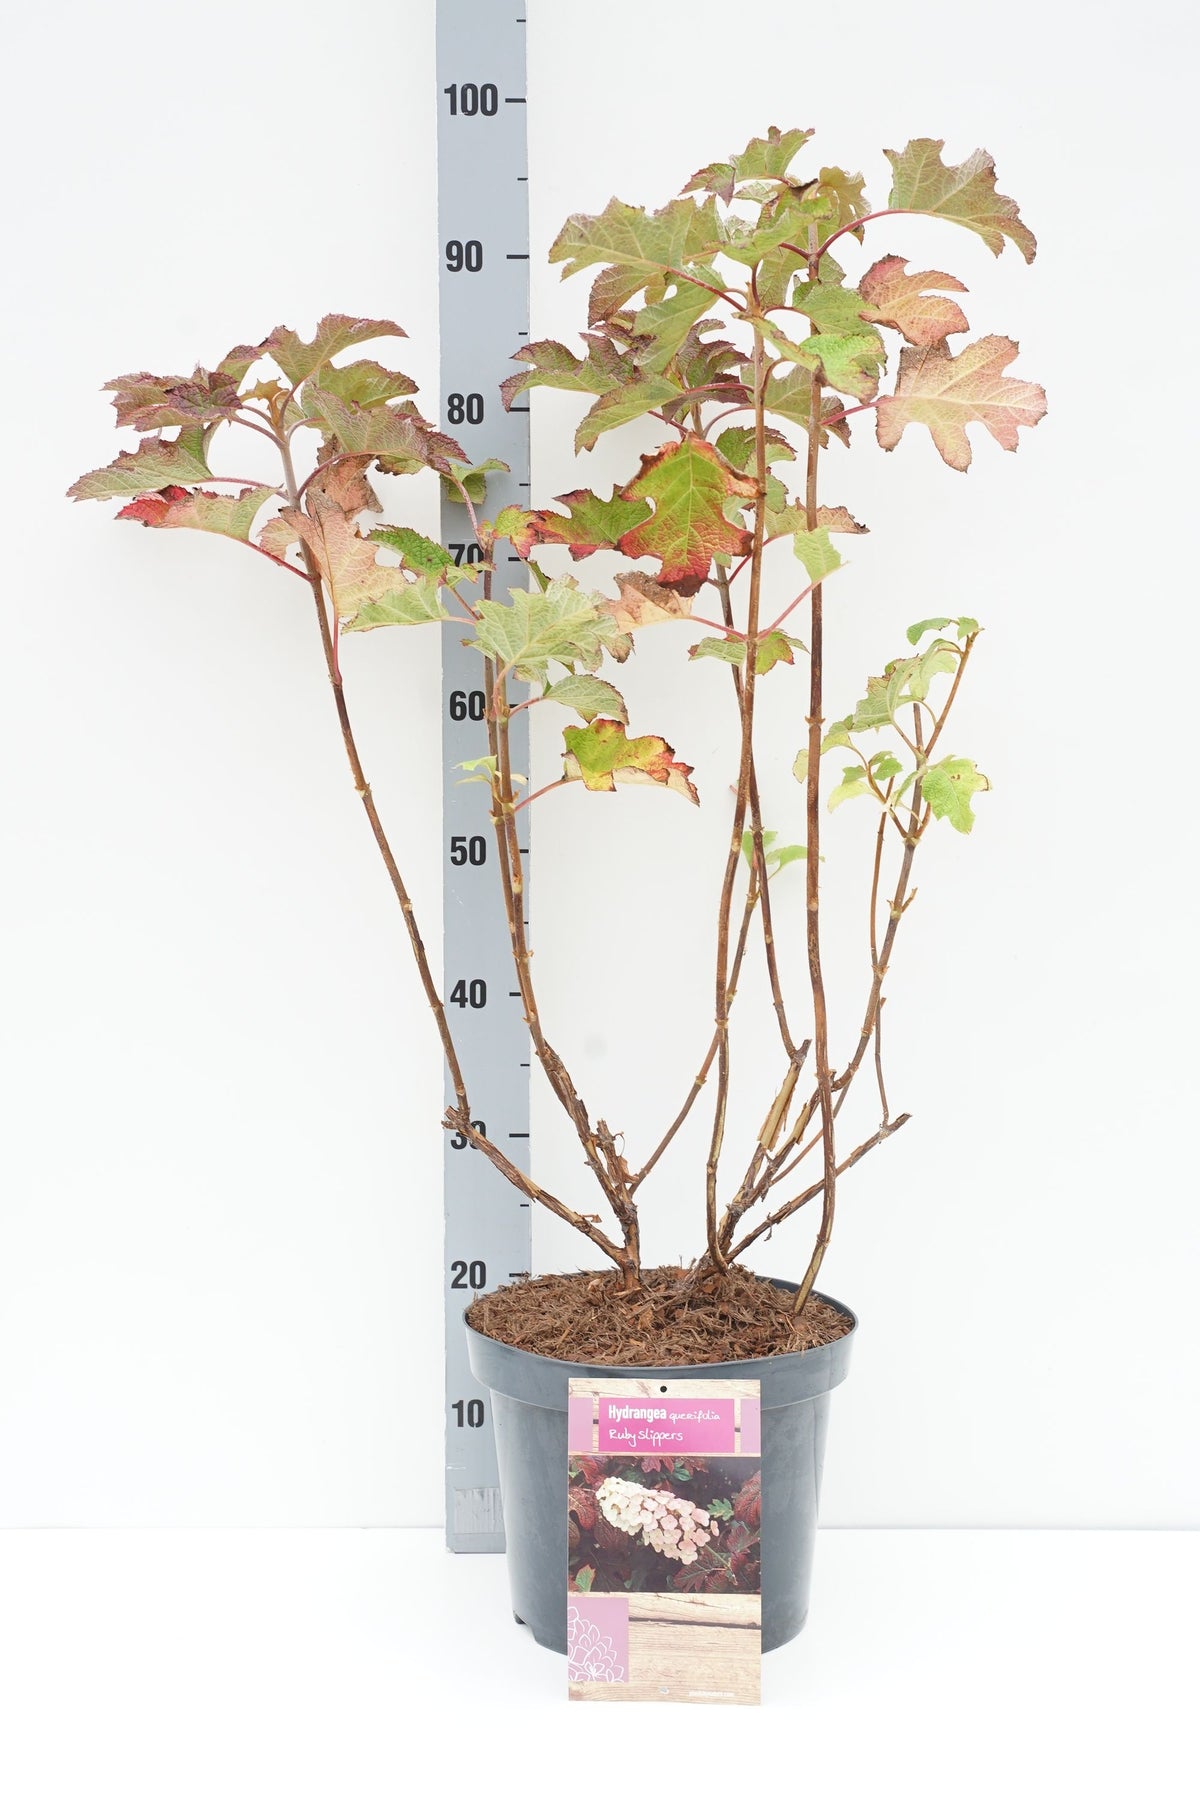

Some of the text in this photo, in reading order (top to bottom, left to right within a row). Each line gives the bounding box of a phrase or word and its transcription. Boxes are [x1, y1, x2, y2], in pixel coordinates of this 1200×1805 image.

[444, 83, 498, 117] 100
[446, 240, 483, 273] 90
[447, 393, 484, 424] 80
[448, 543, 485, 573] 70
[450, 690, 485, 721] 60
[450, 835, 487, 866] 50
[450, 979, 487, 1009] 40
[452, 1260, 487, 1291] 20
[452, 1399, 485, 1428] 10
[608, 1404, 667, 1423] Hydrangea
[609, 1427, 637, 1448] Ruby
